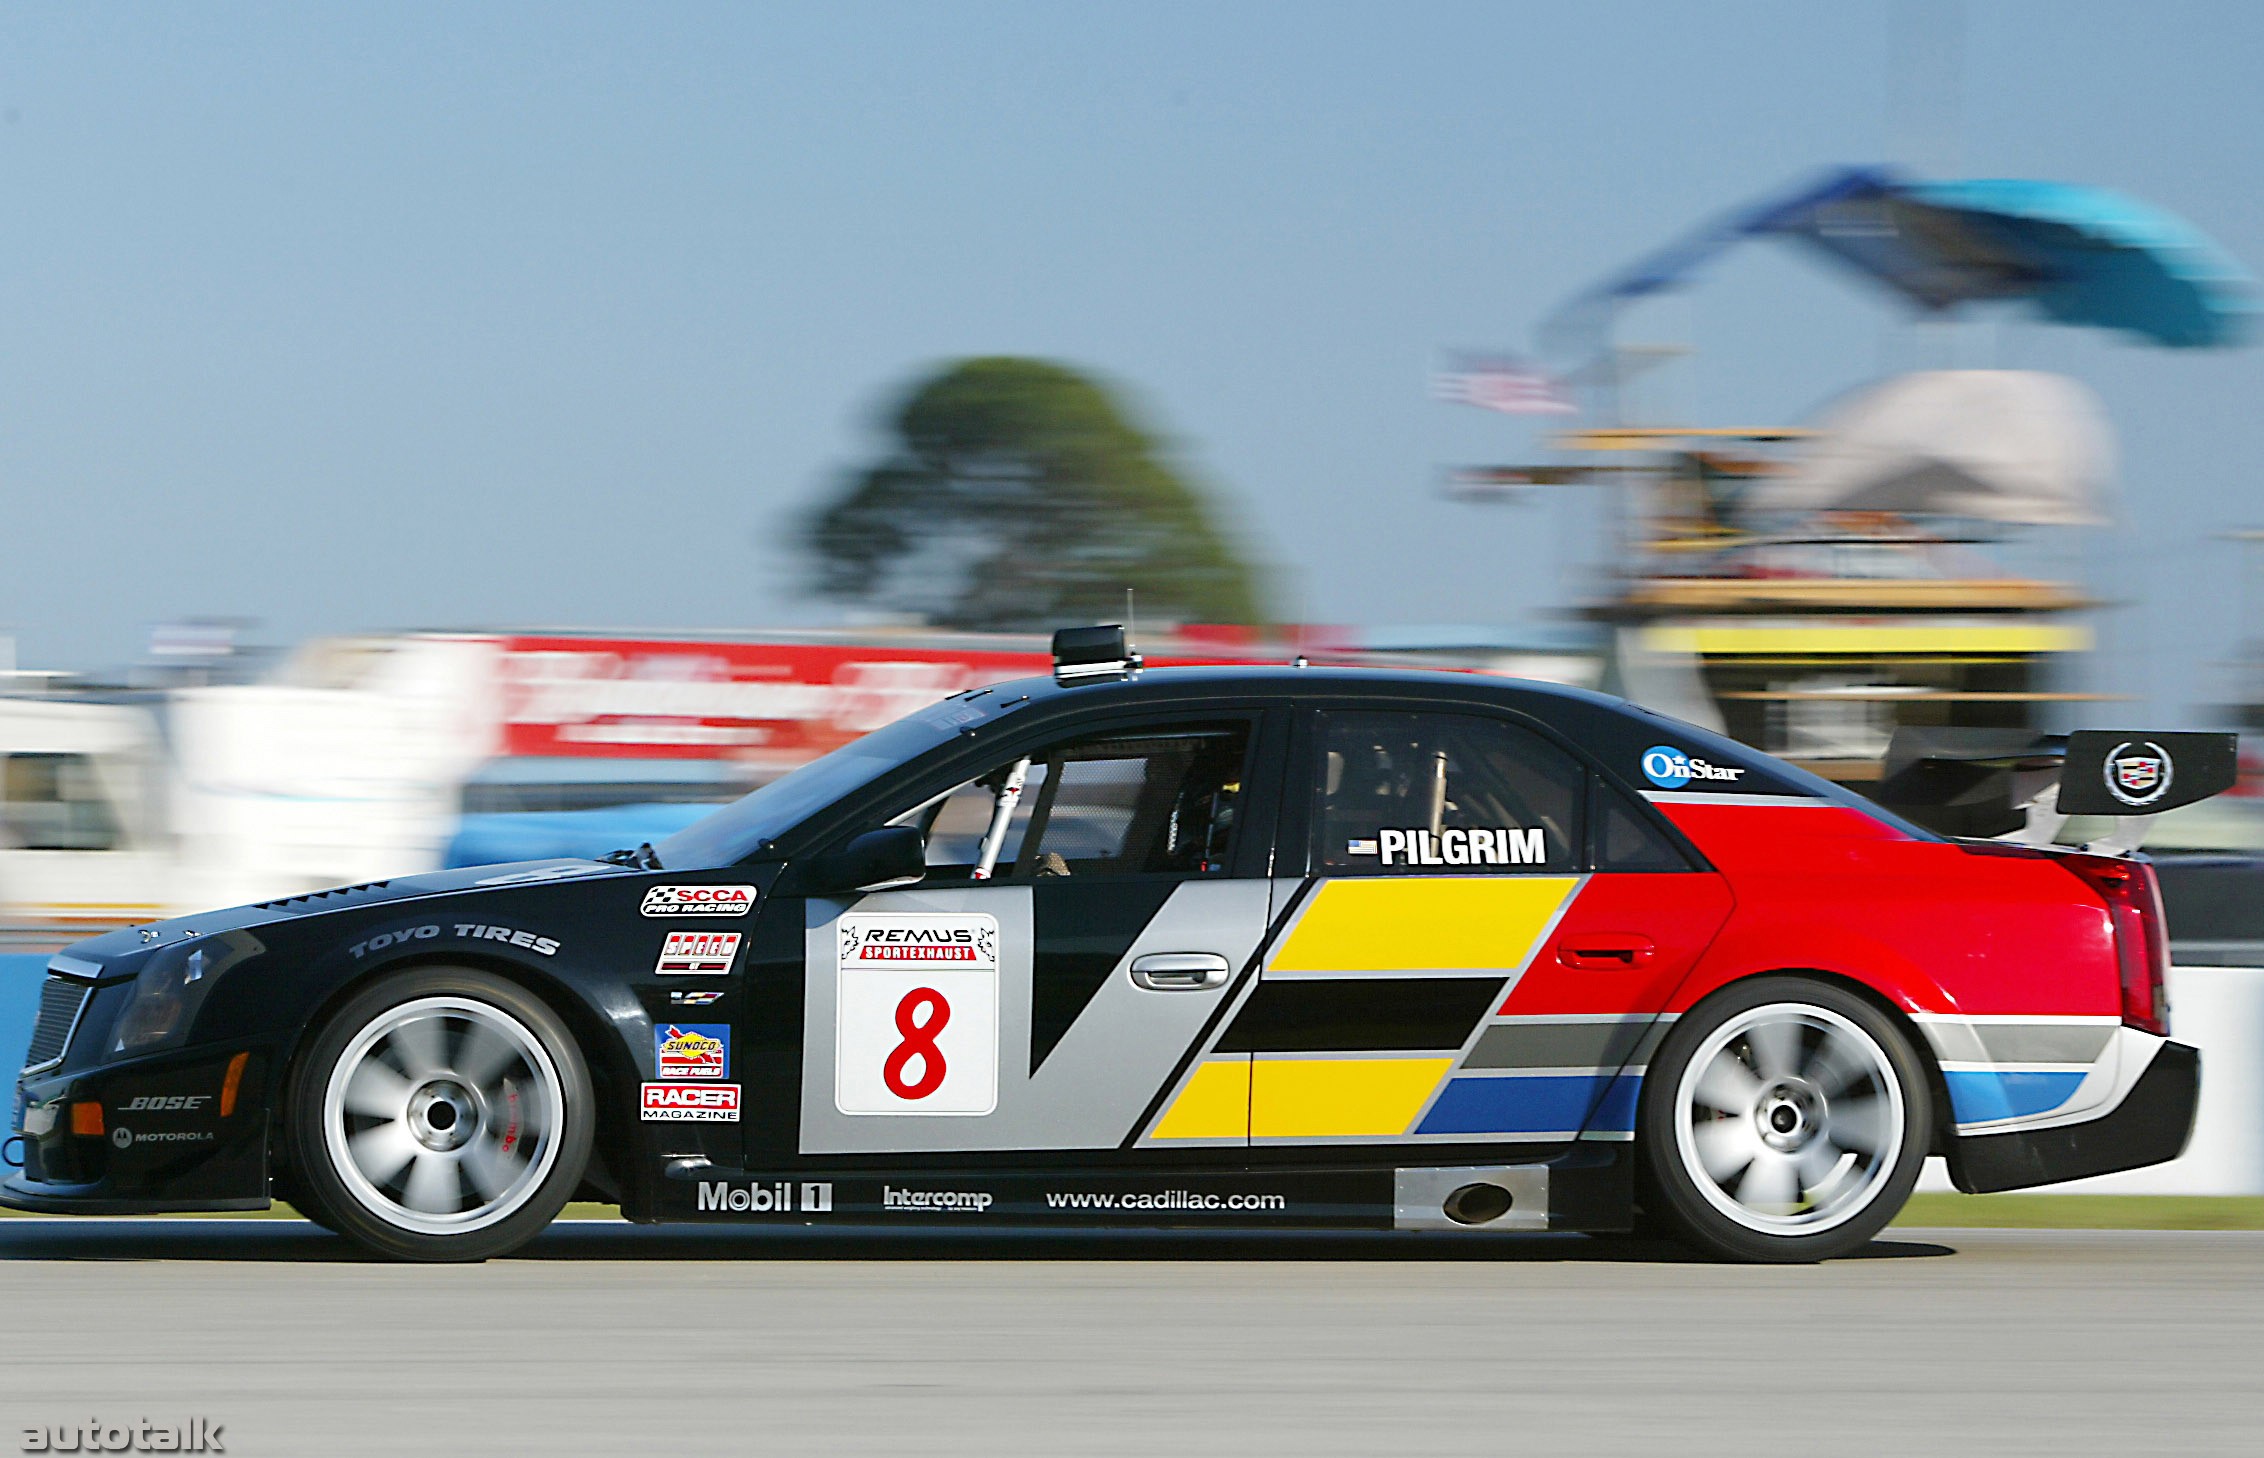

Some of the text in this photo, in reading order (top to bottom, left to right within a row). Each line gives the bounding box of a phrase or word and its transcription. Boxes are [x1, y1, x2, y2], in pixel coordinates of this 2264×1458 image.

[1643, 753, 1744, 780] OnStar
[1380, 828, 1546, 866] PILGRIM
[677, 890, 748, 902] SCCA
[645, 903, 747, 912] PRO RACING
[350, 924, 561, 959] TOYO TIRES
[865, 929, 972, 943] REMUS
[865, 946, 971, 960] SPORTEXHAUST
[667, 1041, 717, 1051] SUNOCO
[883, 986, 951, 1100] 8
[118, 1095, 212, 1110] BOSE
[646, 1088, 736, 1107] RACER
[643, 1110, 738, 1120] MAGAZINE
[135, 1132, 214, 1142] MOTOROLA
[698, 1181, 791, 1212] Mobil
[883, 1185, 993, 1212] Intercomp
[1046, 1190, 1286, 1210] www.cadillac.com
